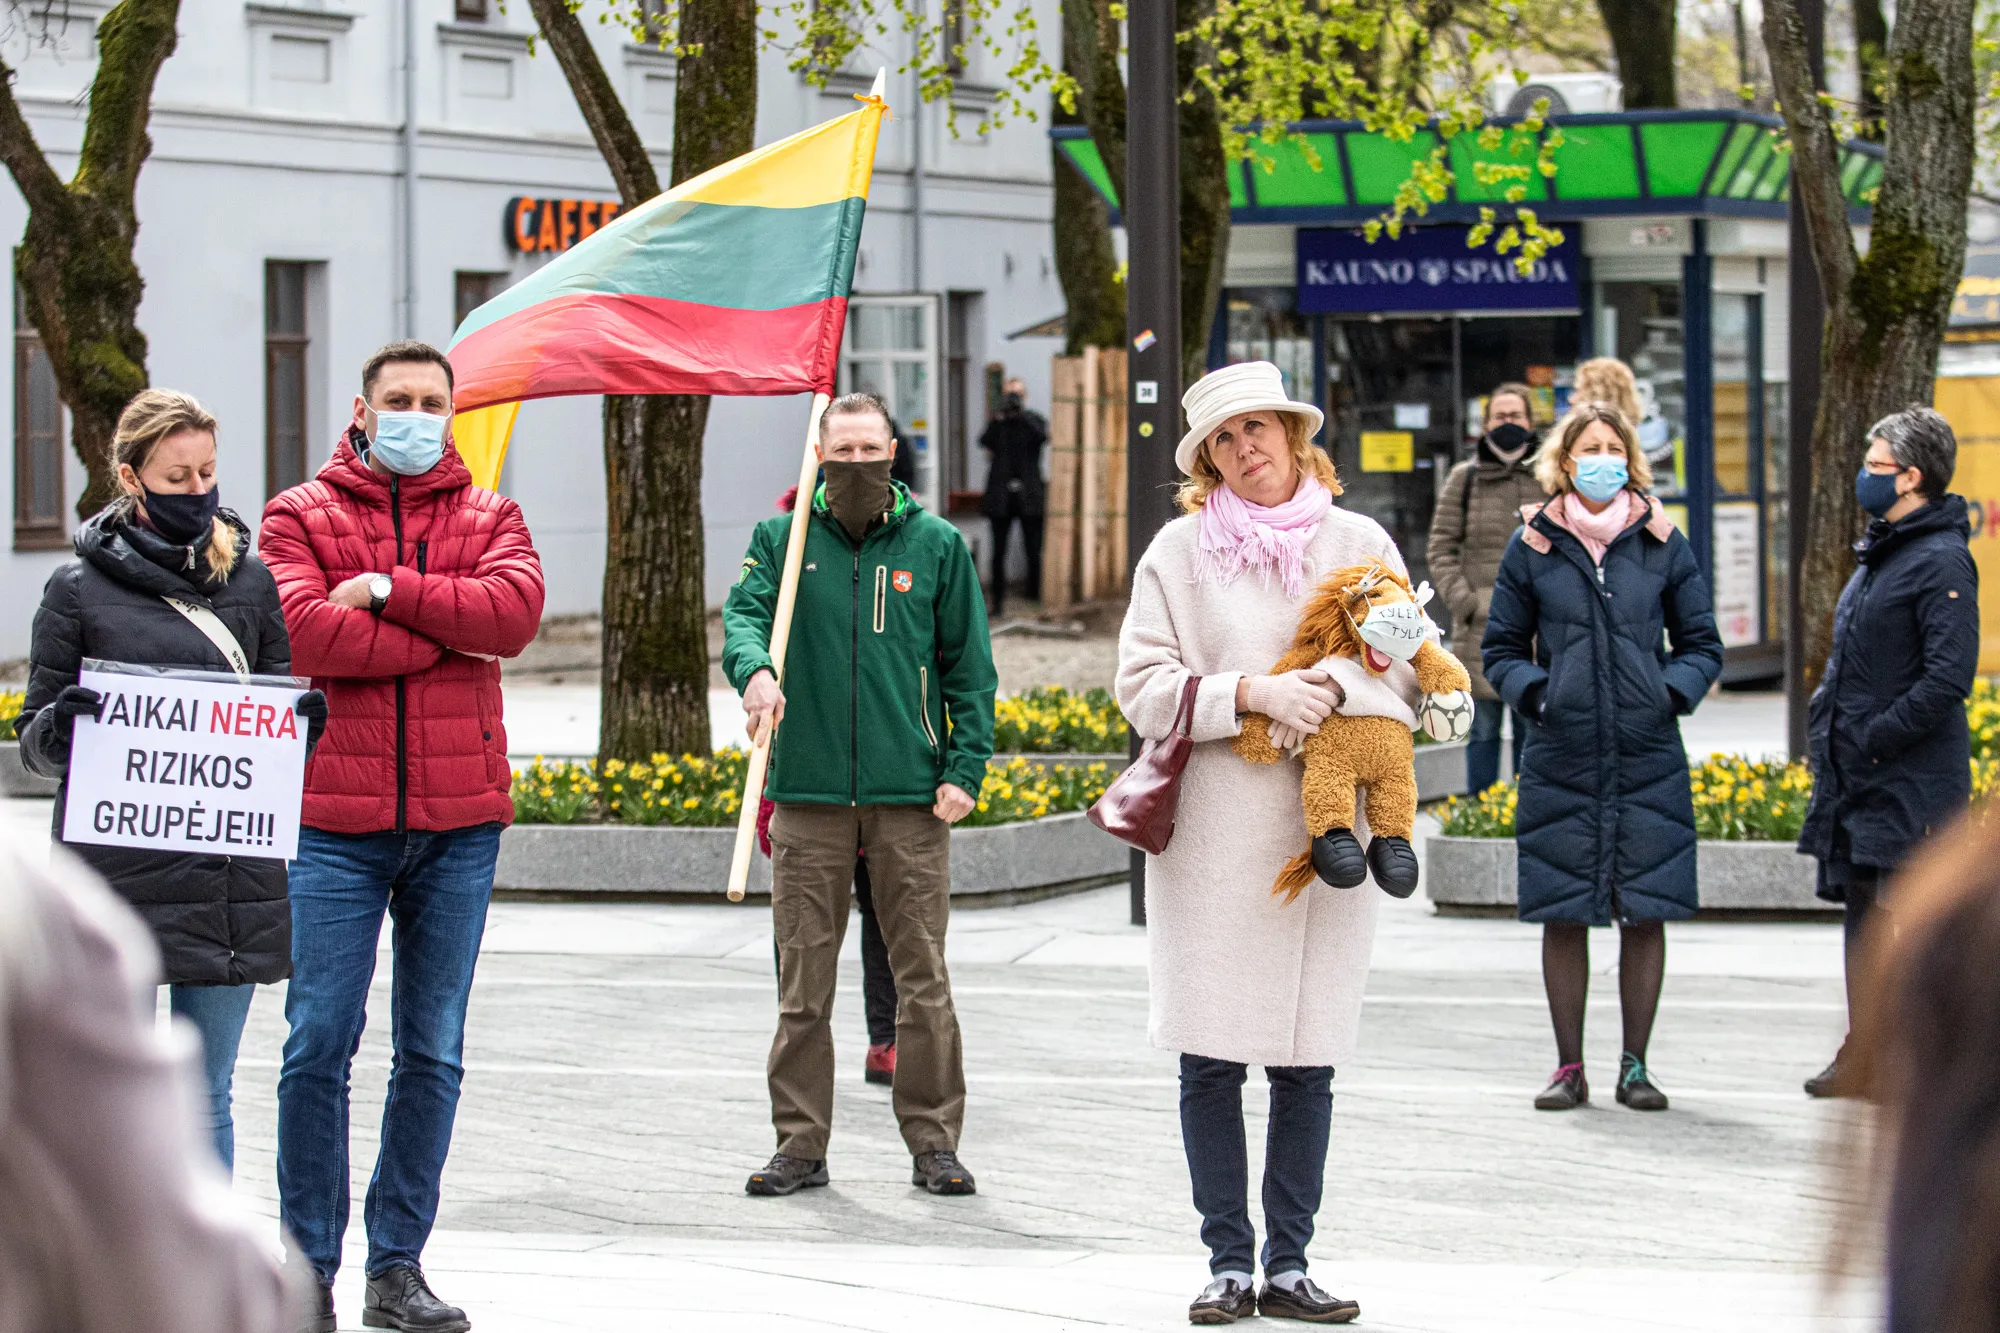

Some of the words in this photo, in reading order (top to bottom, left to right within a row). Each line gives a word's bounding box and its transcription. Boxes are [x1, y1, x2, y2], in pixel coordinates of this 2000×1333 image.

[1306, 259, 1414, 285] KAUNO
[1452, 259, 1568, 285] SPAUDA
[94, 691, 199, 732] VAIKAI
[209, 695, 298, 740] NĖRA
[126, 748, 253, 790] RIZIKOS
[93, 800, 275, 847] GRUPĖJE!!!
